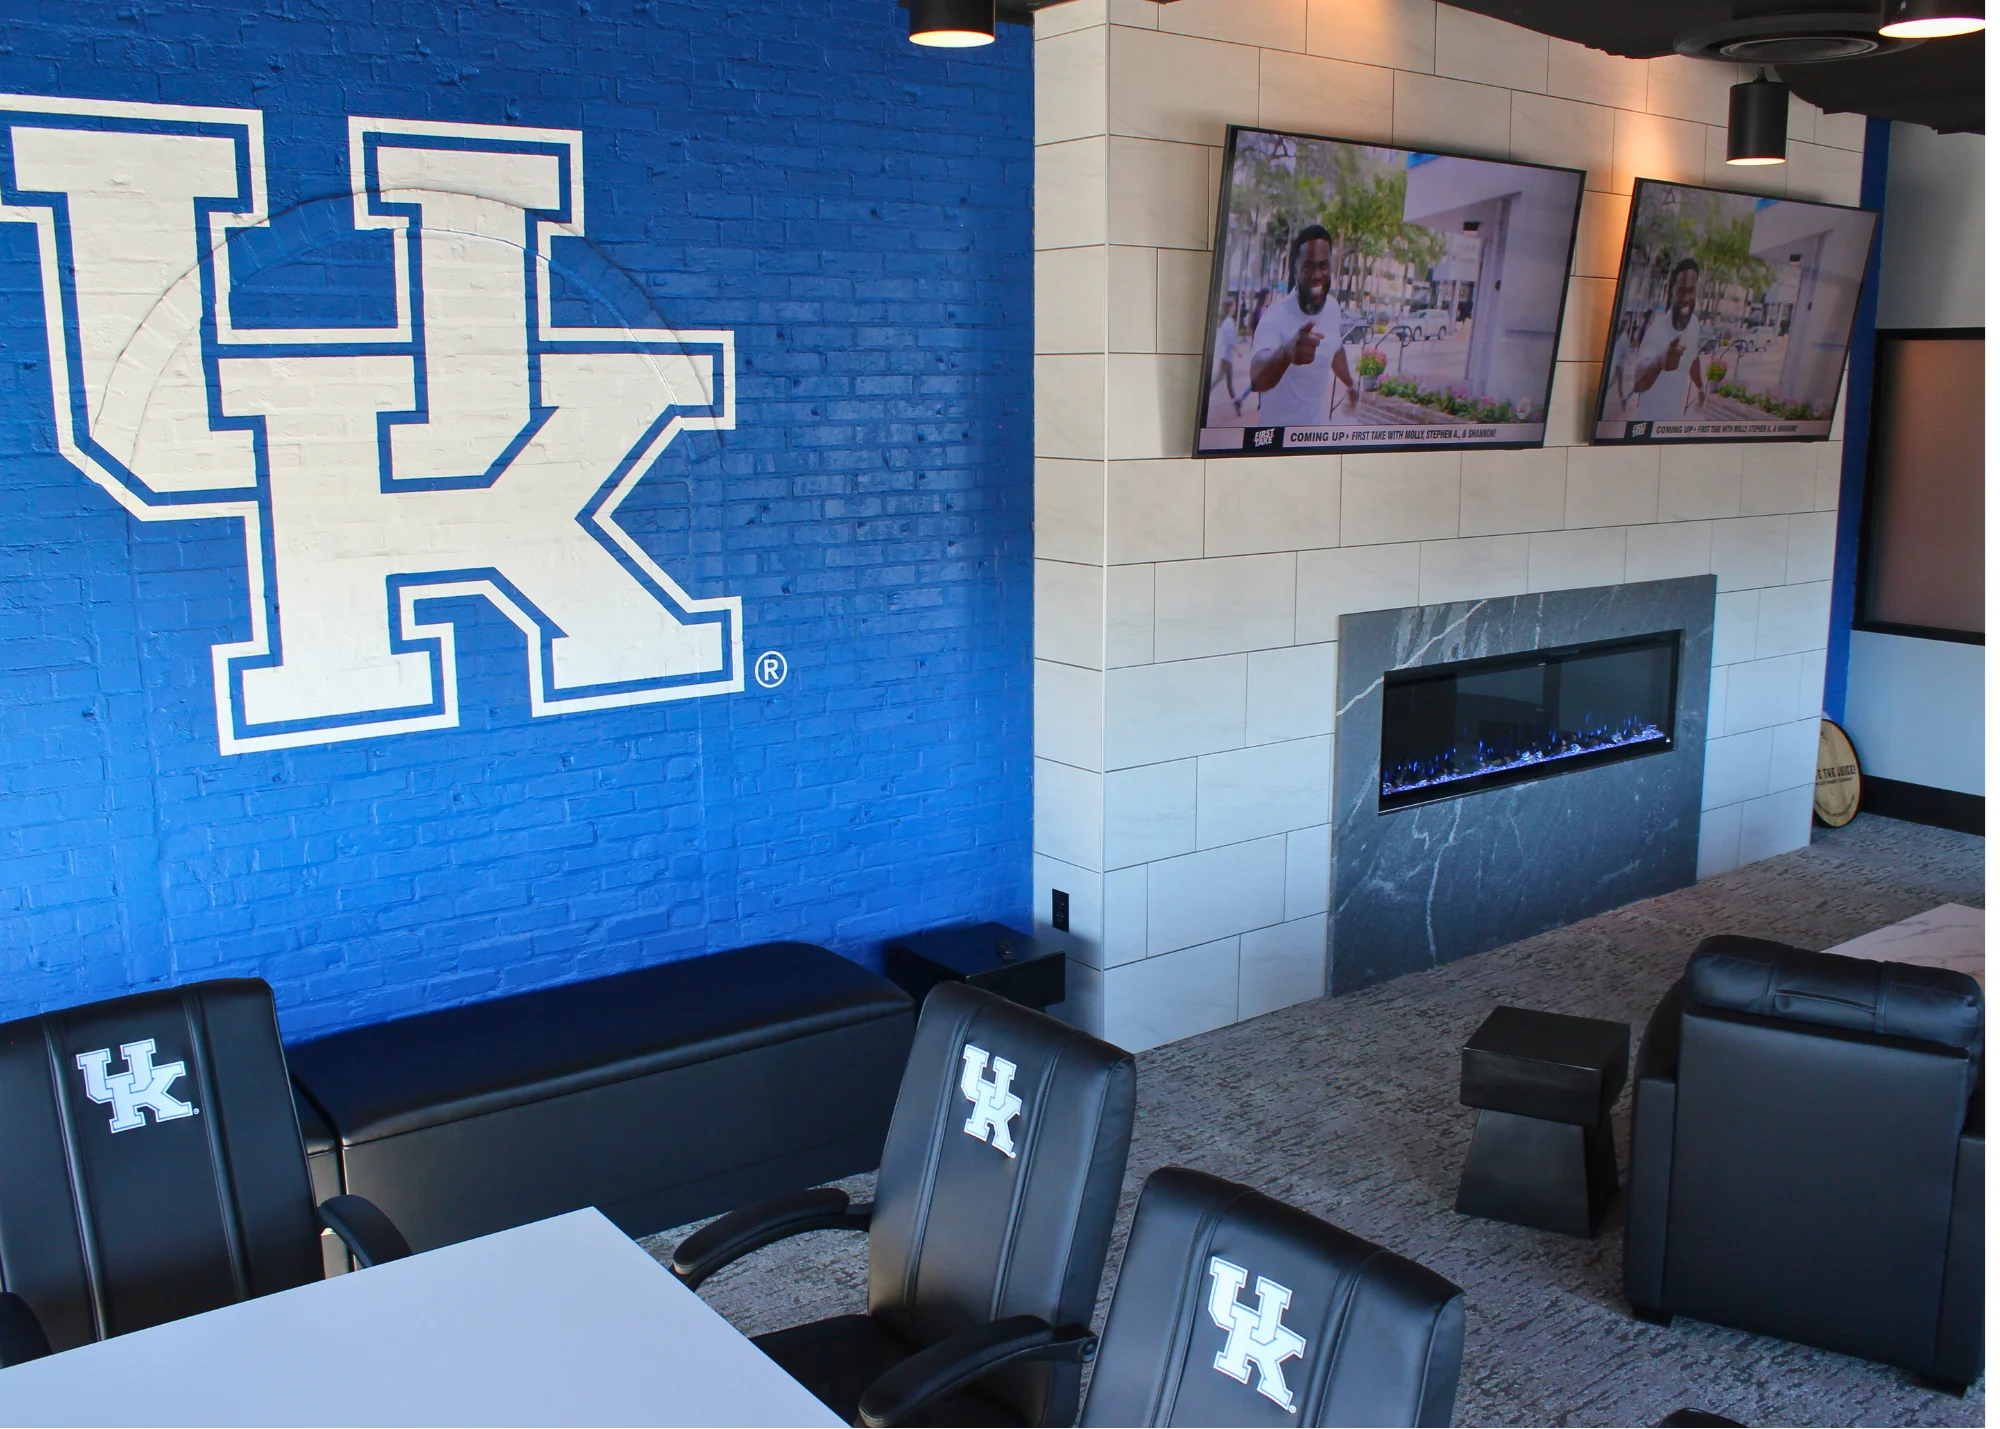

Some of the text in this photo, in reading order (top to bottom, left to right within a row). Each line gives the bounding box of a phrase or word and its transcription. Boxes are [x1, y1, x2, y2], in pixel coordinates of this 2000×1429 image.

[0, 95, 744, 756] UK
[1656, 425, 1693, 434] COMING UP
[1254, 428, 1275, 440] FIRST
[1290, 432, 1345, 442] COMING UP
[1352, 431, 1370, 440] FIRST
[1371, 431, 1387, 440] TAKE
[1387, 430, 1404, 440] WITH
[1404, 430, 1425, 440] MOLLY,
[1426, 430, 1452, 439] STEPHEN
[1462, 430, 1467, 438] &
[1468, 429, 1497, 438] SHANNON!
[1253, 438, 1273, 447] TAKE
[1823, 767, 1836, 778] THE
[76, 1038, 194, 1133] UK
[961, 1044, 1022, 1158] UK
[1208, 1256, 1306, 1411] UK
